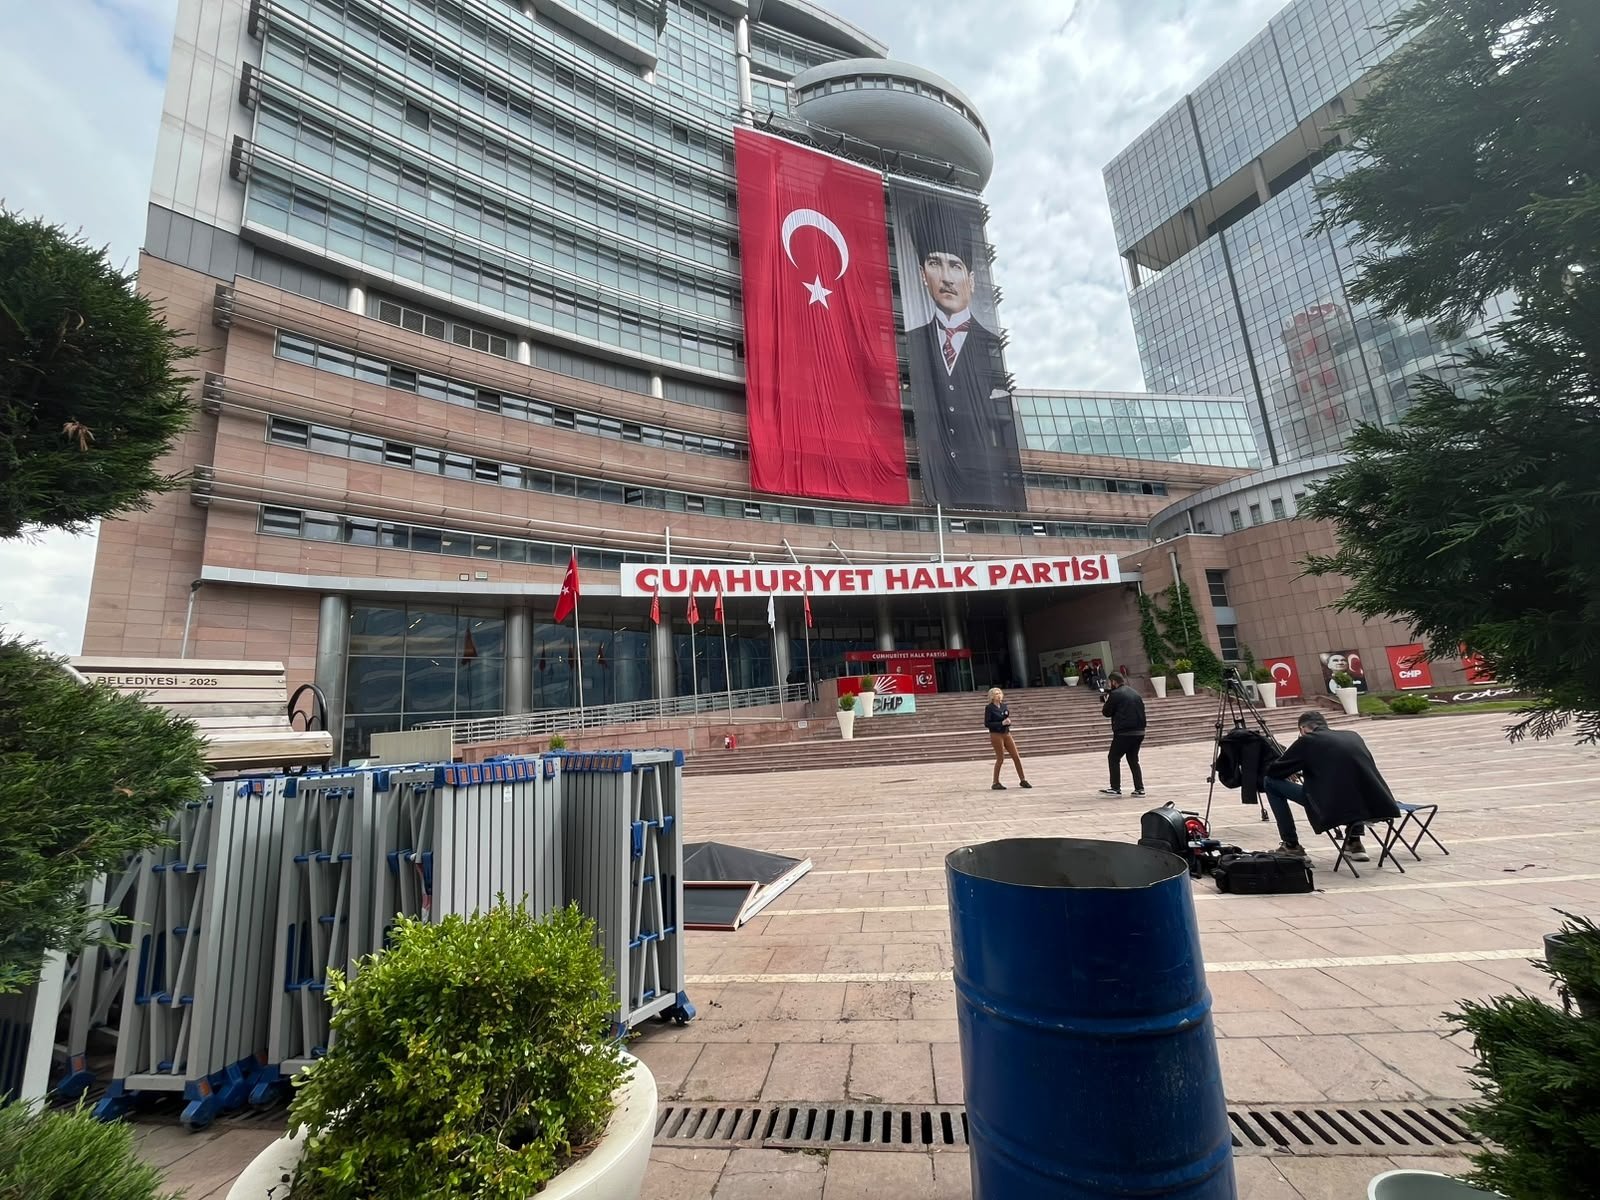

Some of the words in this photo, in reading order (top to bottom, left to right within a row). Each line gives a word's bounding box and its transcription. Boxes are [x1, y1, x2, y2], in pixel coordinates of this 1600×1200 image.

[635, 565, 873, 593] CUMHURİYET
[886, 566, 978, 590] HALK
[988, 555, 1109, 587] PARTİSİ
[872, 651, 908, 659] CUMHURİYET
[1399, 669, 1421, 678] CHP
[97, 675, 178, 685] BELEDİYESİ
[190, 678, 218, 686] 2025
